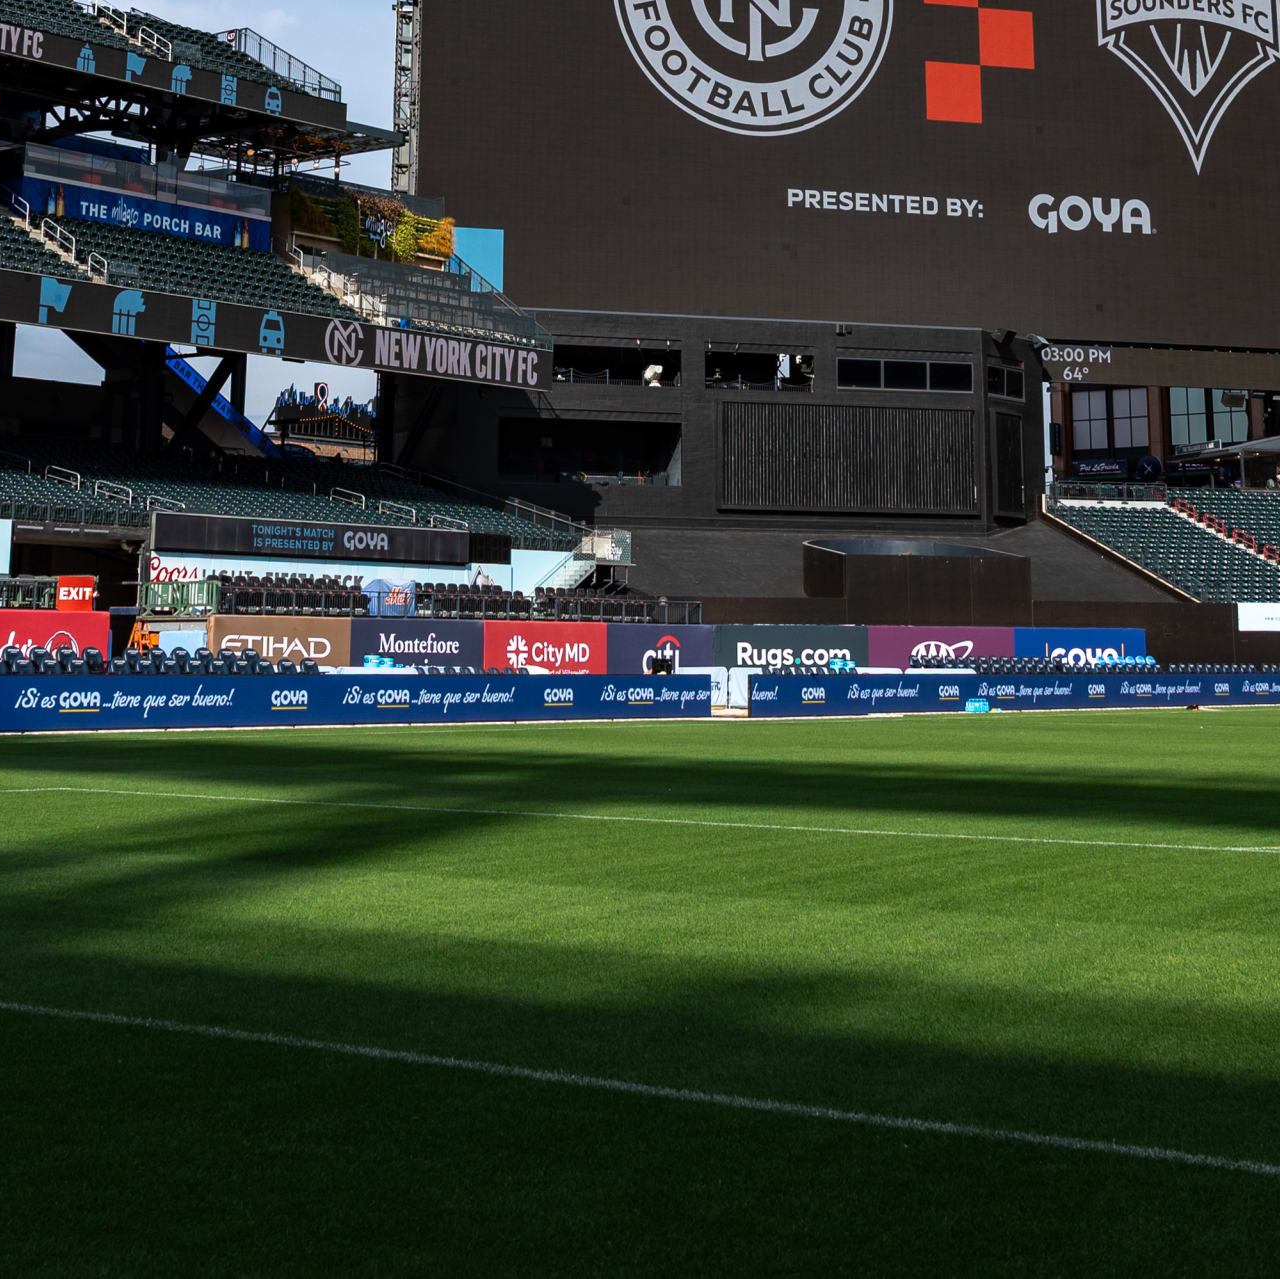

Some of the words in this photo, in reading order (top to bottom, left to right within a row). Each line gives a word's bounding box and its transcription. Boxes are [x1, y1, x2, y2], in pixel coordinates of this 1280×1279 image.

[1242, 3, 1270, 33] FC
[22, 31, 44, 59] FC
[633, 0, 805, 117] FOOTBALL
[808, 15, 874, 99] CLUB
[80, 201, 108, 220] THE
[144, 213, 190, 234] PORCH
[194, 221, 222, 239] BAR
[787, 188, 939, 216] PRESENTED
[947, 198, 984, 218] BY:
[1028, 193, 1152, 234] GOYA
[374, 328, 421, 370] NEW
[424, 335, 472, 378] YORK
[475, 343, 514, 382] CITY
[517, 351, 538, 386] FC
[1041, 347, 1084, 363] 03:00
[1089, 349, 1111, 363] PM
[1063, 366, 1089, 381] 64°
[252, 525, 301, 538] TONIGHT'S
[303, 528, 334, 540] MATCH
[253, 538, 262, 547] IS
[265, 538, 320, 550] PRESENTED
[322, 541, 334, 551] BY
[344, 531, 389, 551] GOYA
[150, 556, 198, 582] Coors
[59, 586, 92, 601] EXIT
[221, 634, 332, 658] ETIHAD
[379, 633, 460, 654] Montefiore
[736, 642, 851, 669] Rugs.com
